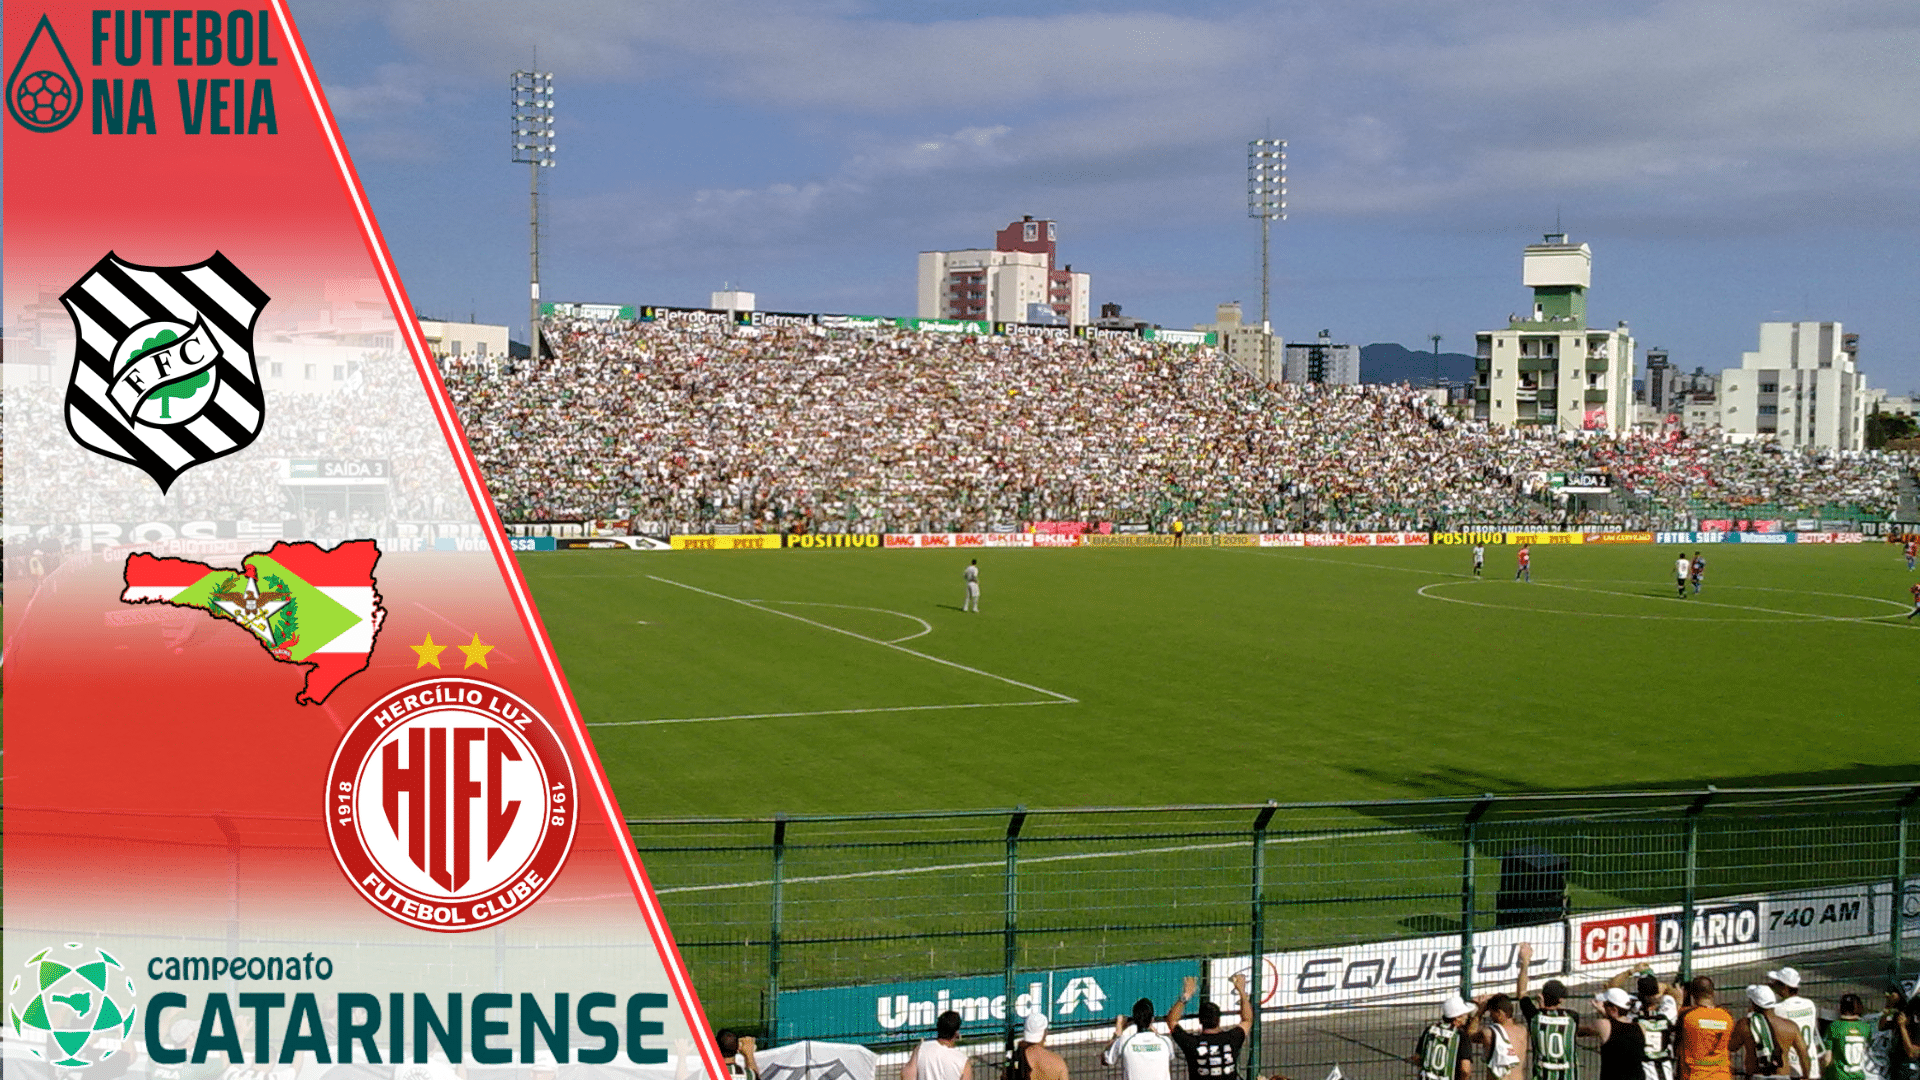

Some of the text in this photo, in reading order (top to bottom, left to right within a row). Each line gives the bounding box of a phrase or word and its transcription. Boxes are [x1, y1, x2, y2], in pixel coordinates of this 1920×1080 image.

[325, 460, 383, 476] SAÍDA 3
[1600, 475, 1607, 487] 2
[787, 534, 879, 548] POSITIVO
[1035, 533, 1077, 543] SKILL
[1263, 533, 1301, 542] SKILL
[1306, 533, 1344, 543] SKILL
[1433, 532, 1503, 545] POSITIVO
[1834, 533, 1863, 543] JEANS
[1584, 922, 1650, 963] CBN
[1769, 907, 1815, 931] 740
[1819, 901, 1861, 924] AM
[877, 982, 1043, 1029] Unimed
